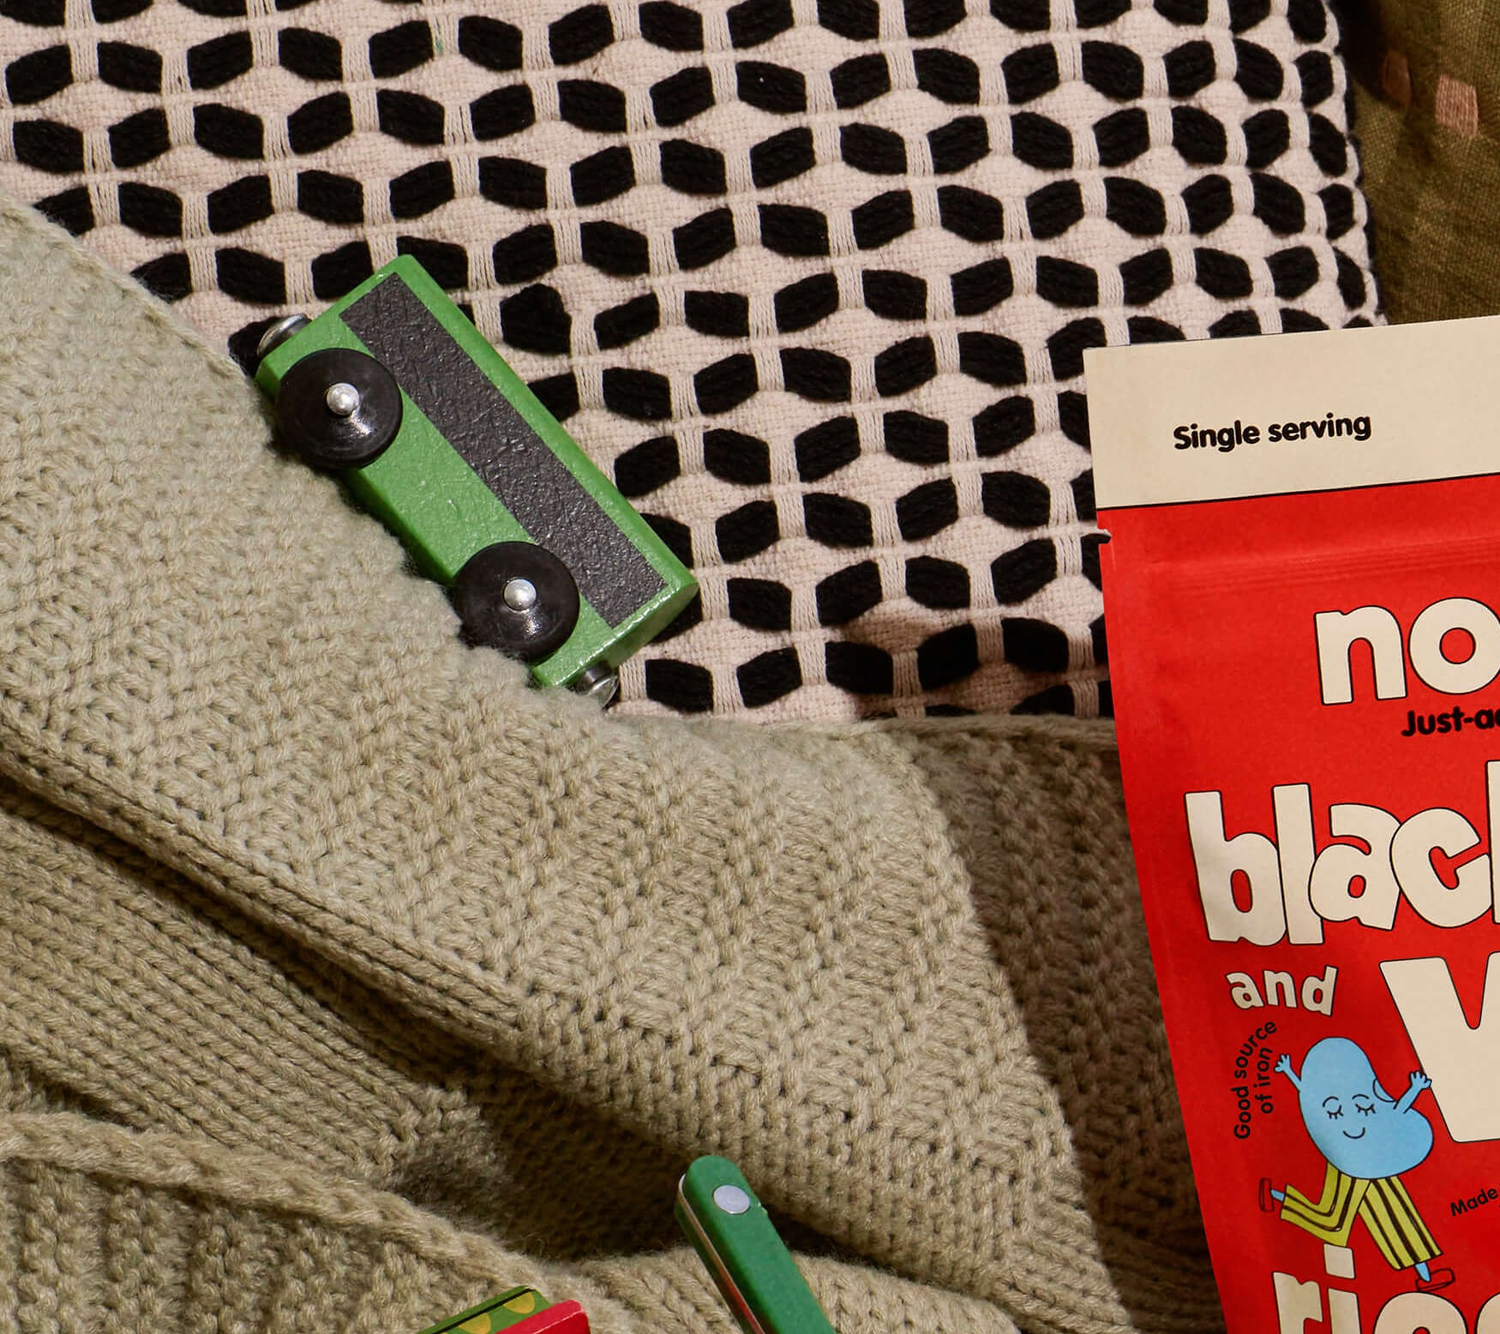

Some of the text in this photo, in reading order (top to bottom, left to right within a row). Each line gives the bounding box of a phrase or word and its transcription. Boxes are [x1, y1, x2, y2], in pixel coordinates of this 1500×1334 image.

[1173, 413, 1371, 452] Single serving
[1226, 964, 1338, 1017] and
[1230, 1021, 1278, 1139] Good source
[1253, 1047, 1274, 1114] of iron
[1450, 1187, 1499, 1217] Made
